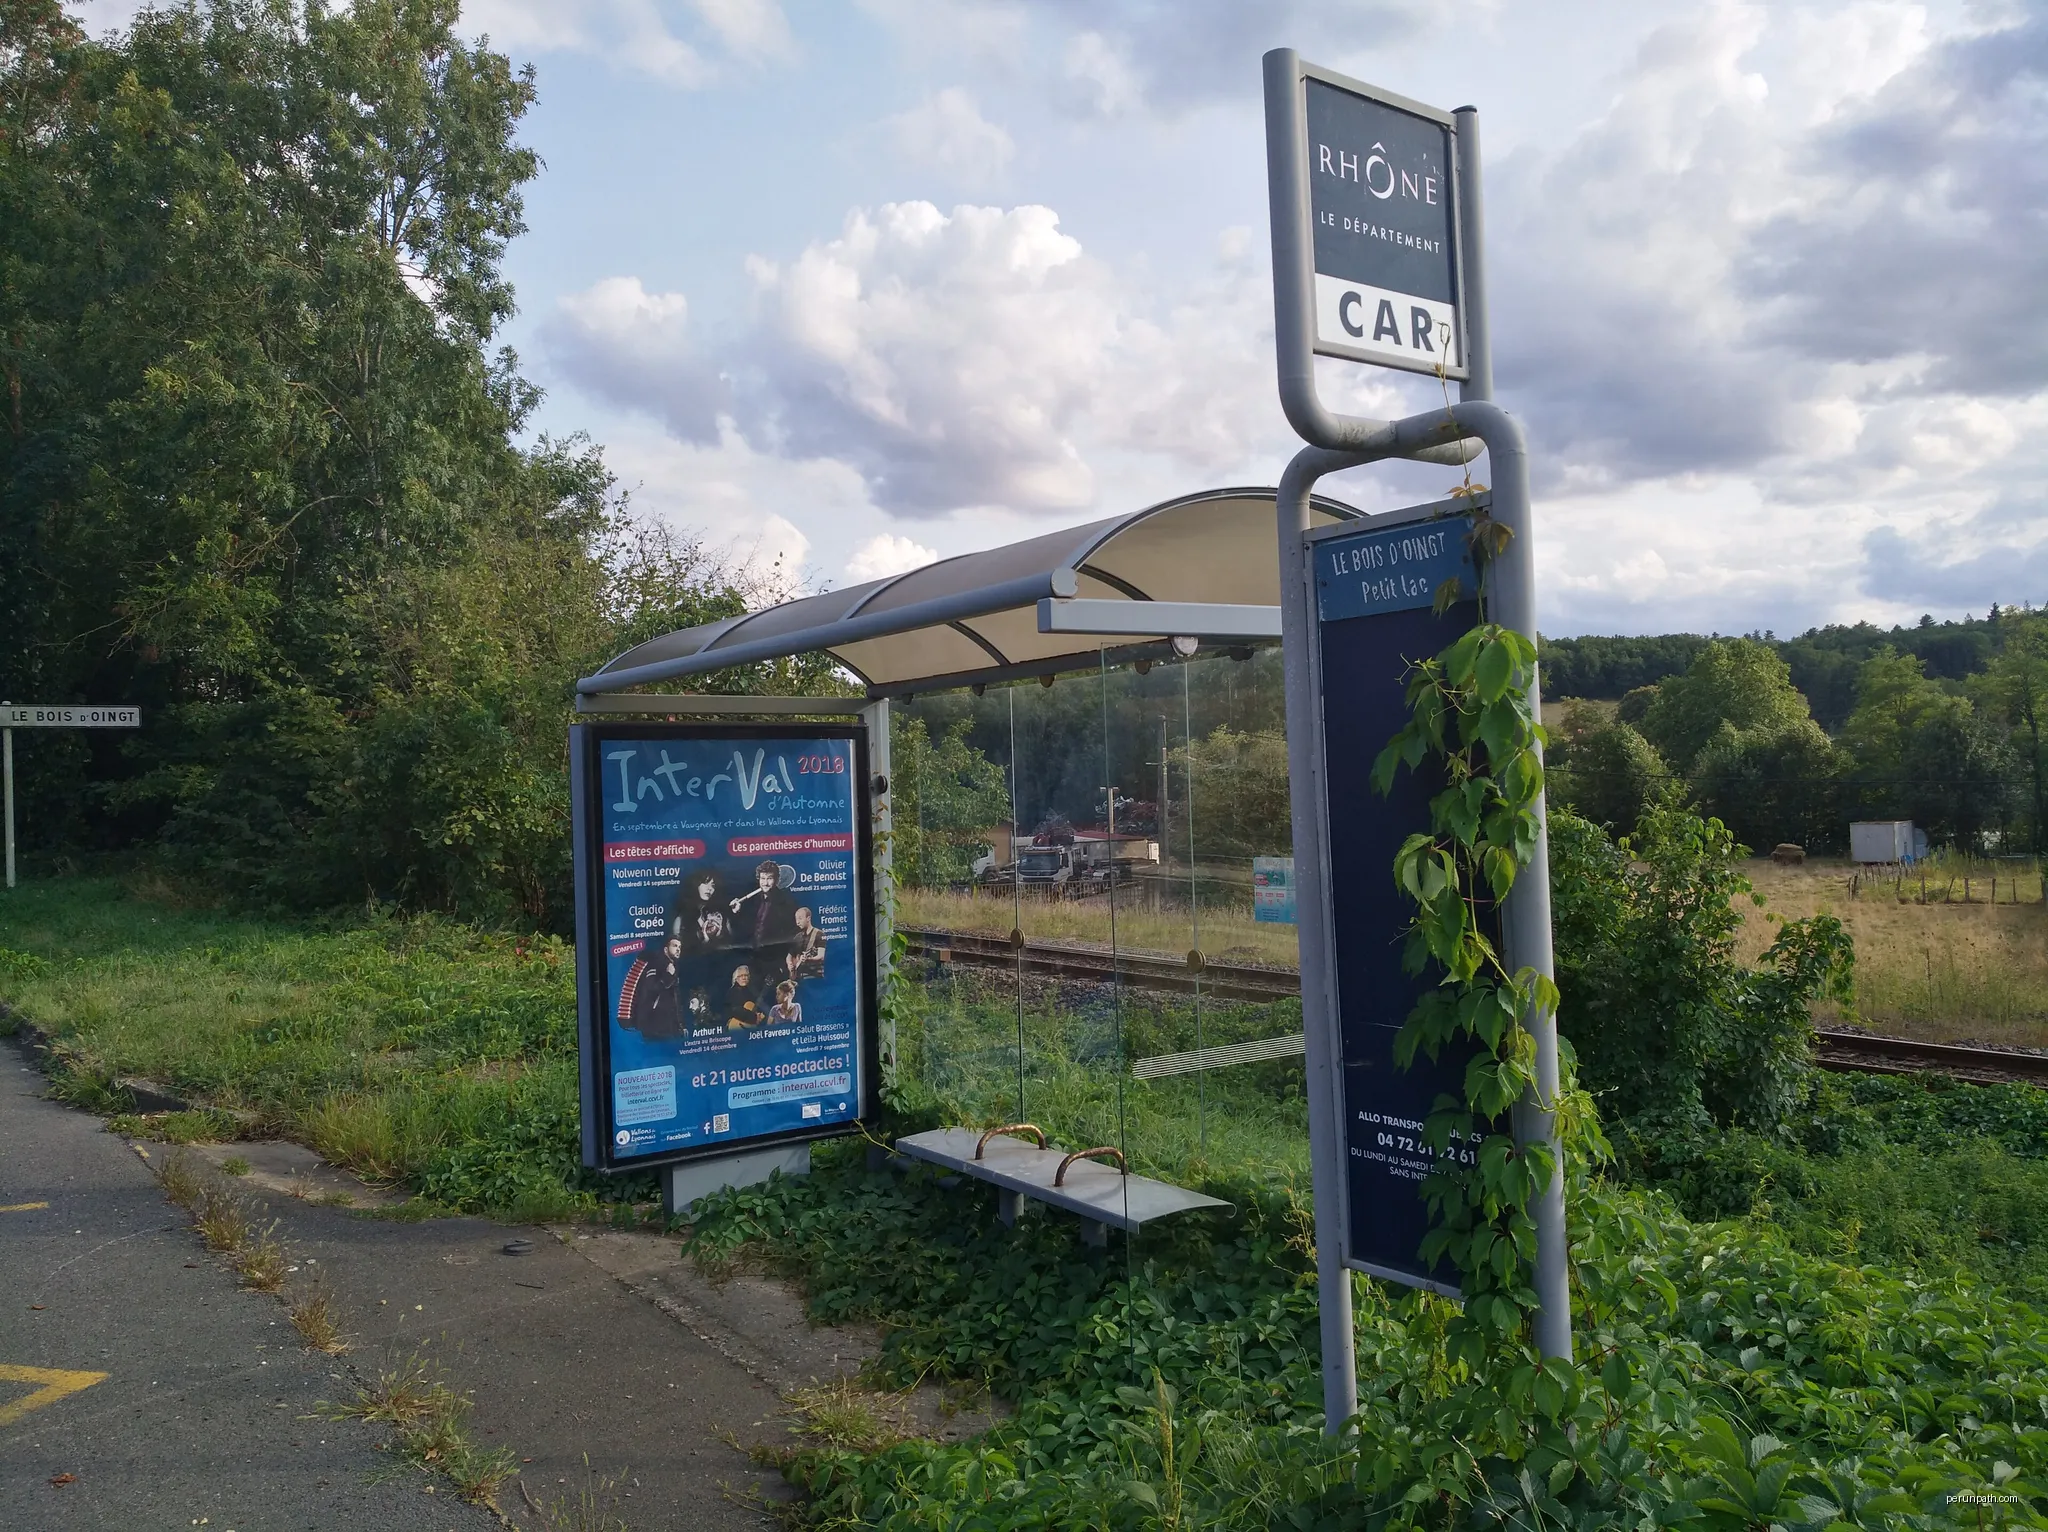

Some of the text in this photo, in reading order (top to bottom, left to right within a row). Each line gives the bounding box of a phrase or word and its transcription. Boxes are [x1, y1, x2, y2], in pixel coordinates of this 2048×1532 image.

[1318, 141, 1438, 206] RHÔNE
[1320, 211, 1440, 254] LE DÉPARTEMENT
[1338, 290, 1436, 353] CAR
[1332, 532, 1446, 576] LE BOIS D'OINGT
[1361, 577, 1398, 604] Petit
[11, 711, 28, 722] LE
[36, 711, 73, 722] BOIS
[798, 754, 845, 774] 2018
[767, 795, 845, 811] d'Automne
[612, 815, 843, 832] En septembre à Vaugneray et dans les Vallons du Lyonnais
[609, 844, 695, 858] Les têtes d'affiche
[732, 838, 846, 853] Les parenthèses d'humour
[818, 859, 847, 870] Olivier
[612, 866, 681, 879] Nolwenn Leroy
[800, 871, 847, 883] De Benoist
[617, 880, 643, 888] Vendredi
[651, 879, 681, 887] septembre
[628, 903, 664, 916] Claudio
[818, 904, 848, 915] Frédéric
[634, 917, 665, 930] Capéo
[820, 915, 848, 925] Fromet
[609, 931, 630, 940] Samedi
[634, 931, 665, 939] septembre
[613, 943, 640, 955] COMPLET
[692, 1026, 723, 1038] Arthur H
[748, 1030, 764, 1040] Joël
[764, 1029, 791, 1038] Favreau
[796, 1025, 815, 1035] Salut
[815, 1023, 845, 1032] Brassens
[791, 1037, 799, 1045] et
[817, 1031, 850, 1042] Huissoud
[679, 1047, 703, 1055] Vendredi
[710, 1043, 737, 1051] décembre
[692, 1073, 706, 1088] et
[709, 1070, 727, 1086] 21
[729, 1066, 772, 1083] autres
[774, 1056, 843, 1078] spectacles
[732, 1088, 776, 1101] Programme
[781, 1076, 847, 1093] interval.ccvl.fr
[1358, 1110, 1380, 1123] ALLO
[1382, 1115, 1424, 1132] TRANSPO
[666, 1131, 692, 1141] Facebook
[1377, 1132, 1394, 1148] 04
[1397, 1136, 1414, 1152] 72
[1459, 1149, 1475, 1165] 61
[1350, 1146, 1361, 1157] DU
[1363, 1149, 1386, 1162] LUNDI
[1387, 1155, 1398, 1165] AU
[1400, 1157, 1429, 1171] SAMEDI
[1389, 1166, 1410, 1178] SANS
